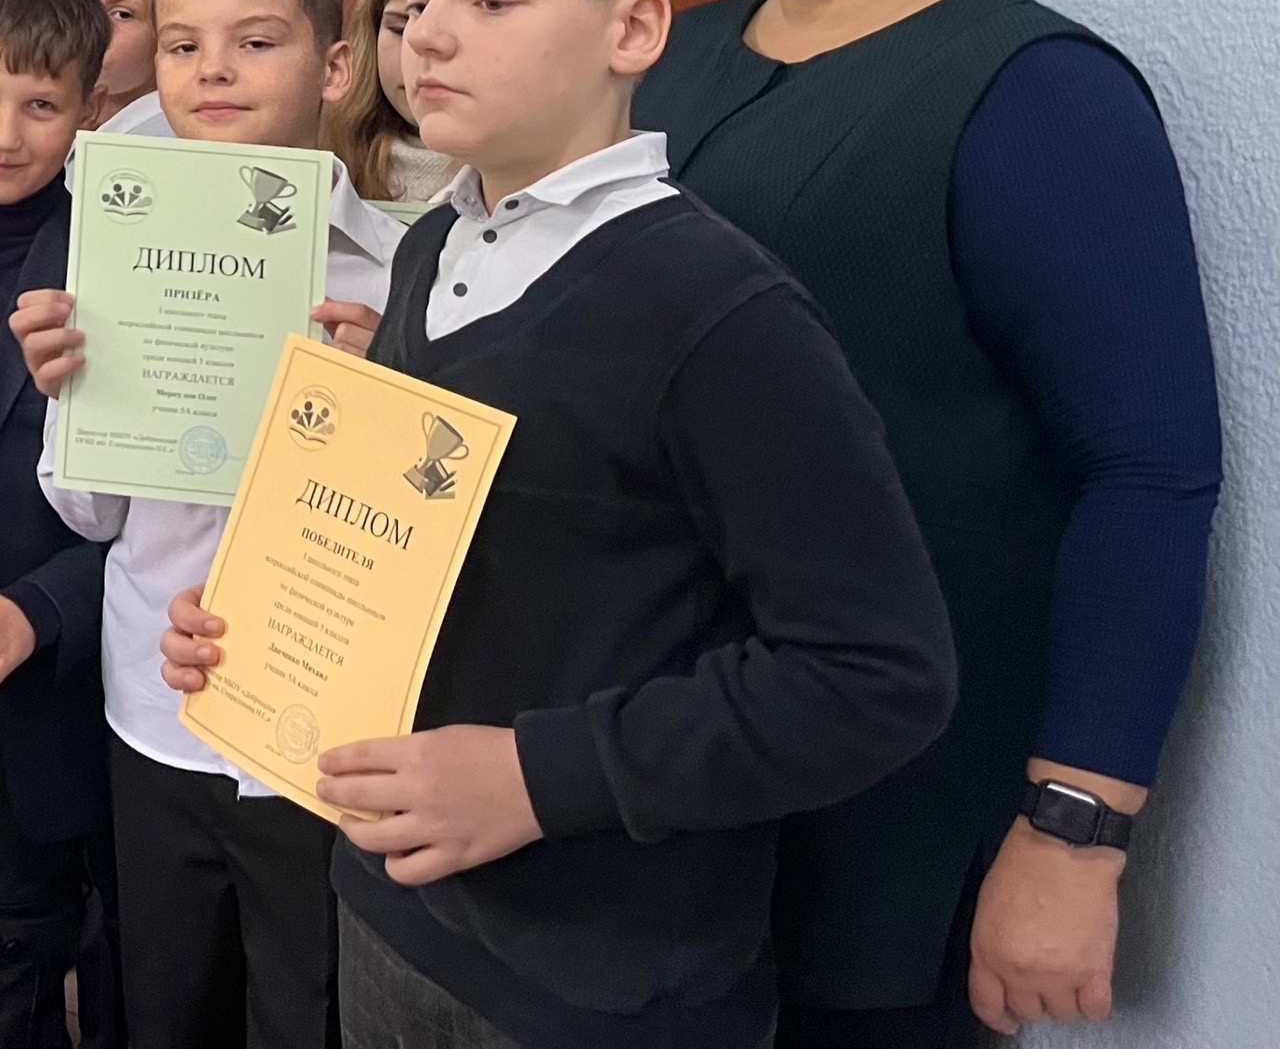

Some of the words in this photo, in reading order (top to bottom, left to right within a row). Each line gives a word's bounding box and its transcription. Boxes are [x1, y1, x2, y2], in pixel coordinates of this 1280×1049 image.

[132, 247, 266, 279] ДИПЛОМ
[164, 288, 220, 302] ПРИЗЁРА
[142, 368, 234, 386] НАГРАЖДАЕТСЯ
[295, 479, 414, 550] ДИПЛОМ
[301, 527, 374, 570] ПОБЕДИТЕЛЯ
[268, 617, 344, 666] НАГРАЖДАЕТСЯ
